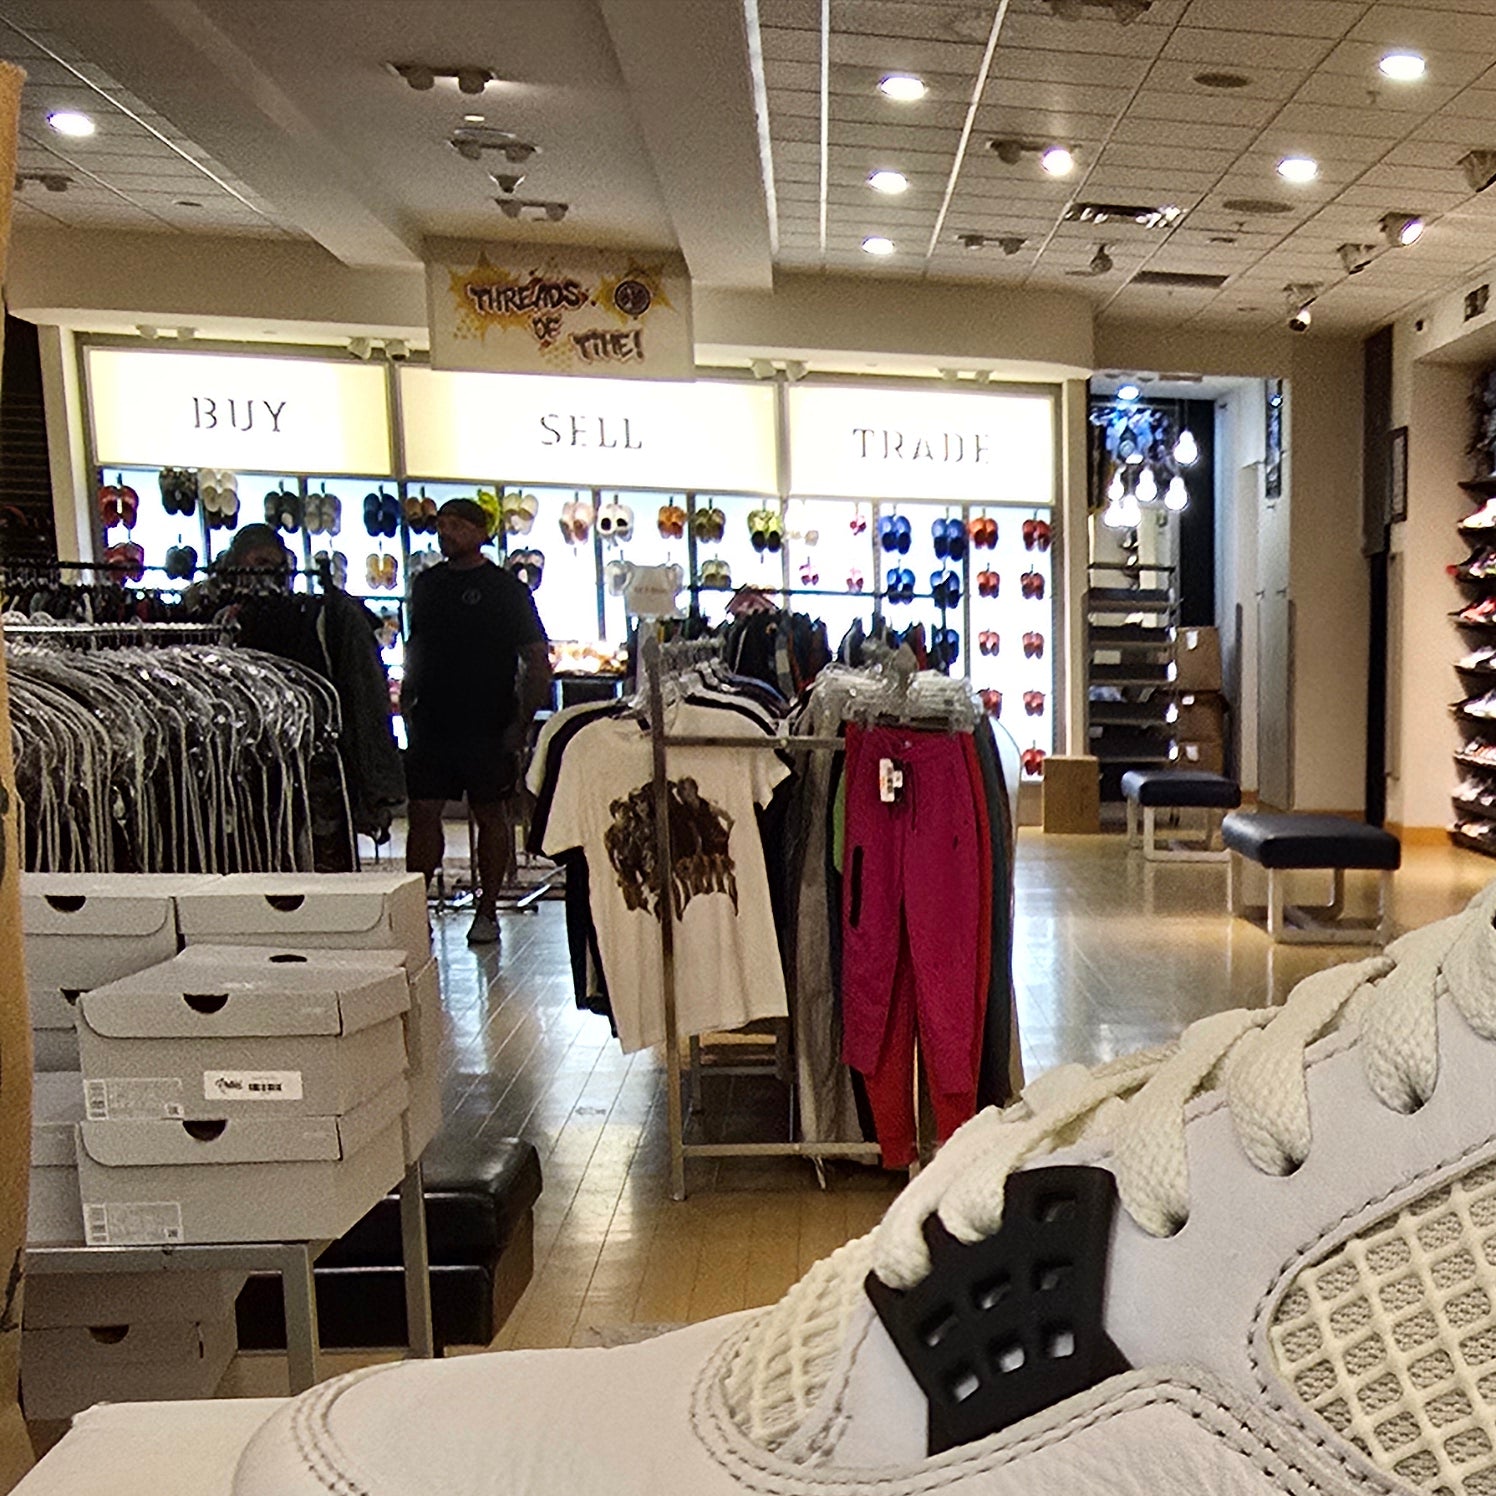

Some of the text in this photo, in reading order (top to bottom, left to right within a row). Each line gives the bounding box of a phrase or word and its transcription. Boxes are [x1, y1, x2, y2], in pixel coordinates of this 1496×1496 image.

[467, 279, 584, 314] THREADS
[192, 396, 287, 433] BUY
[539, 413, 643, 450] SELL
[852, 427, 990, 465] TRADE
